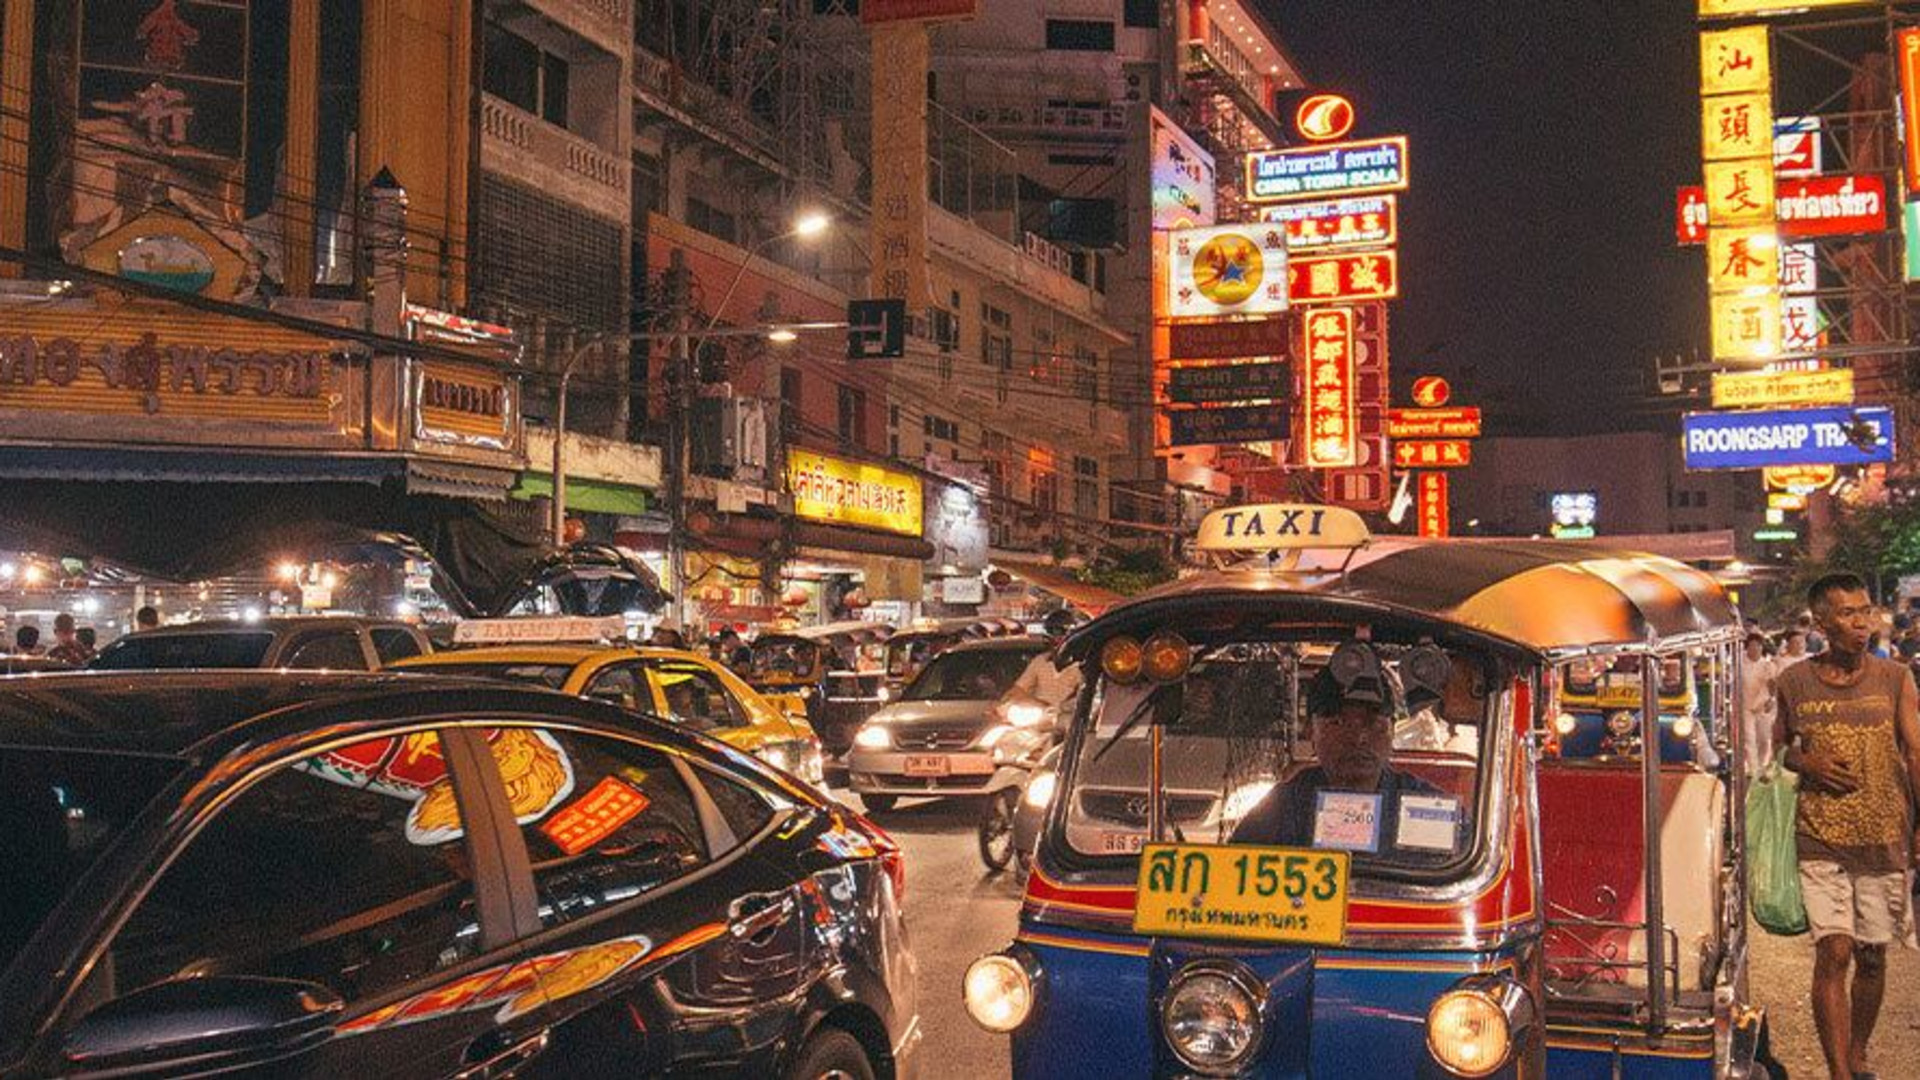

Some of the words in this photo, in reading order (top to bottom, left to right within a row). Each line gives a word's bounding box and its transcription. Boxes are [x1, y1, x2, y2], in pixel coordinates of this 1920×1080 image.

[1255, 177, 1300, 195] CHINA
[1304, 172, 1347, 190] TOWN
[1349, 168, 1398, 186] SCALA
[1690, 424, 1808, 453] ROONGSARP
[1222, 509, 1326, 537] TAXI
[1149, 849, 1211, 894] สก
[1234, 852, 1338, 901] 1553
[1165, 907, 1310, 931] กรุงเทพมหานคร
